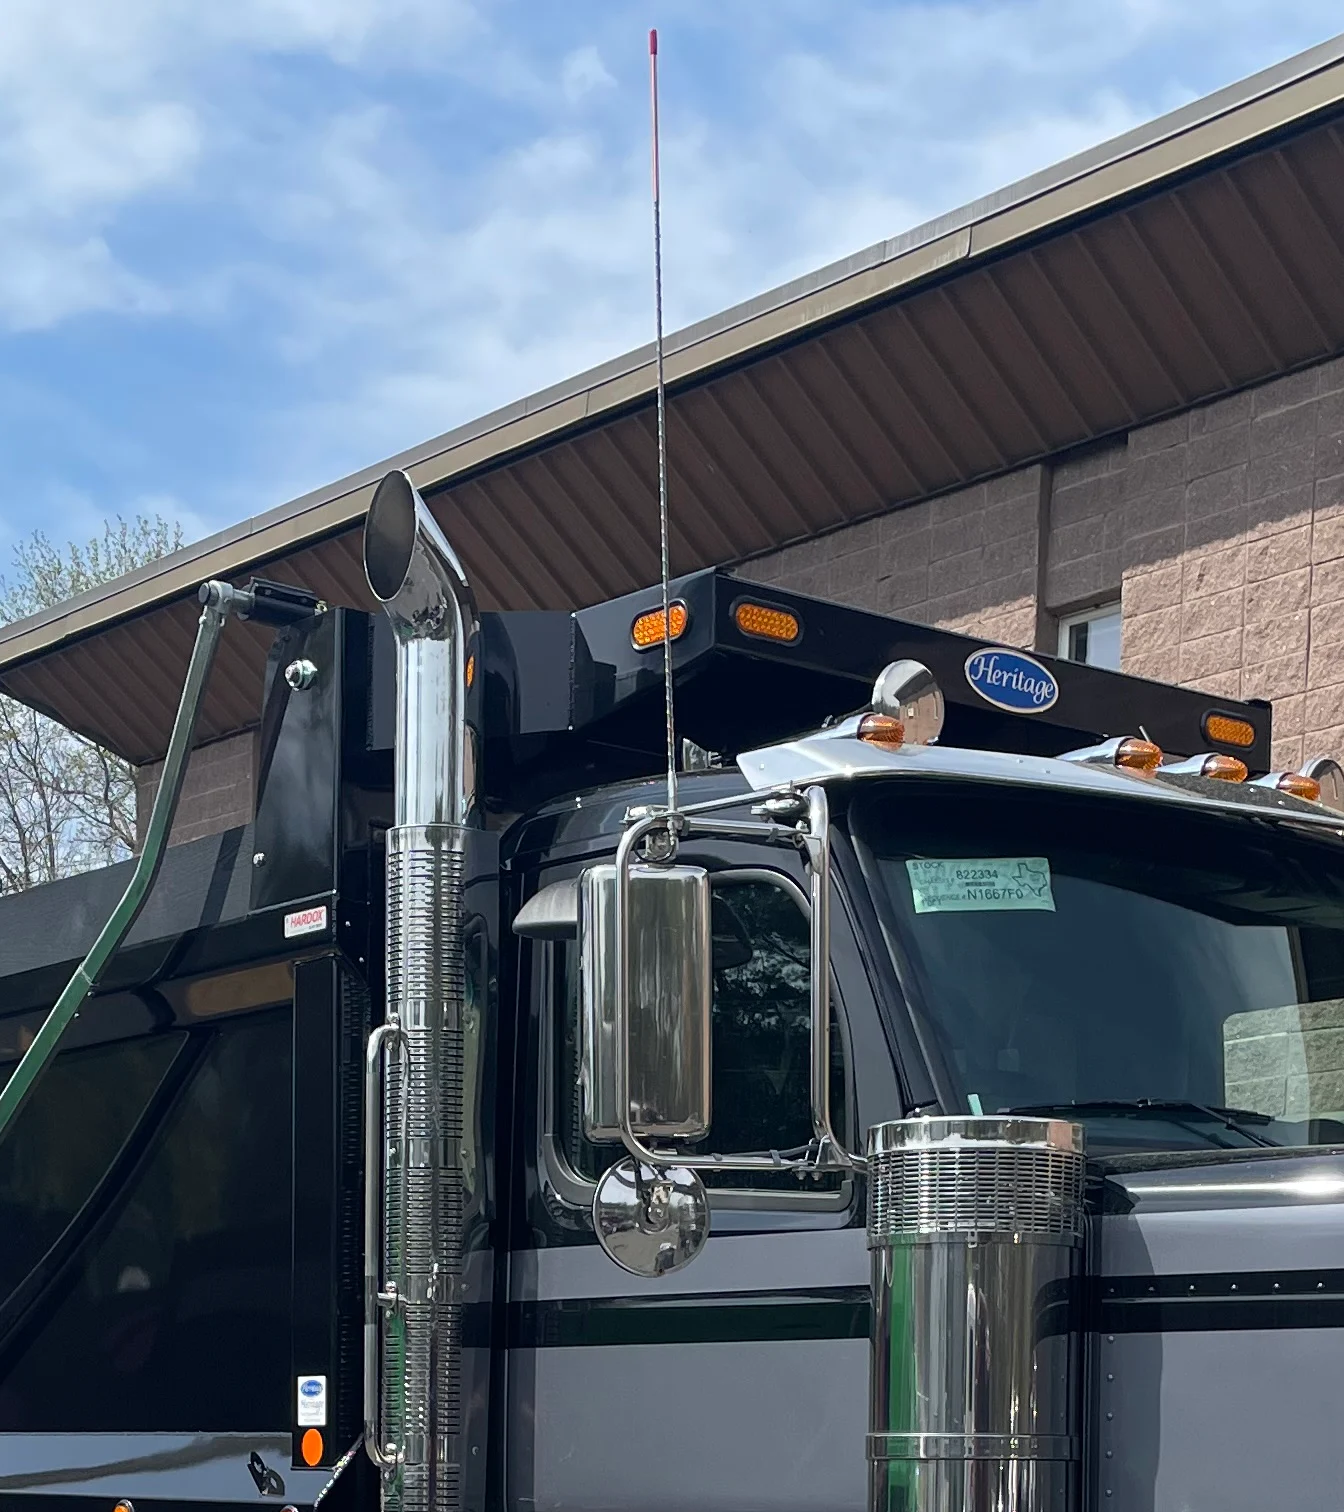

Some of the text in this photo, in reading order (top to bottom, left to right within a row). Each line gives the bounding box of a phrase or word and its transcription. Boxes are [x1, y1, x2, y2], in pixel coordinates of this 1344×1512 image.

[970, 655, 1054, 705] Heritage
[955, 869, 1000, 880] 822334
[290, 910, 323, 927] HARDOX
